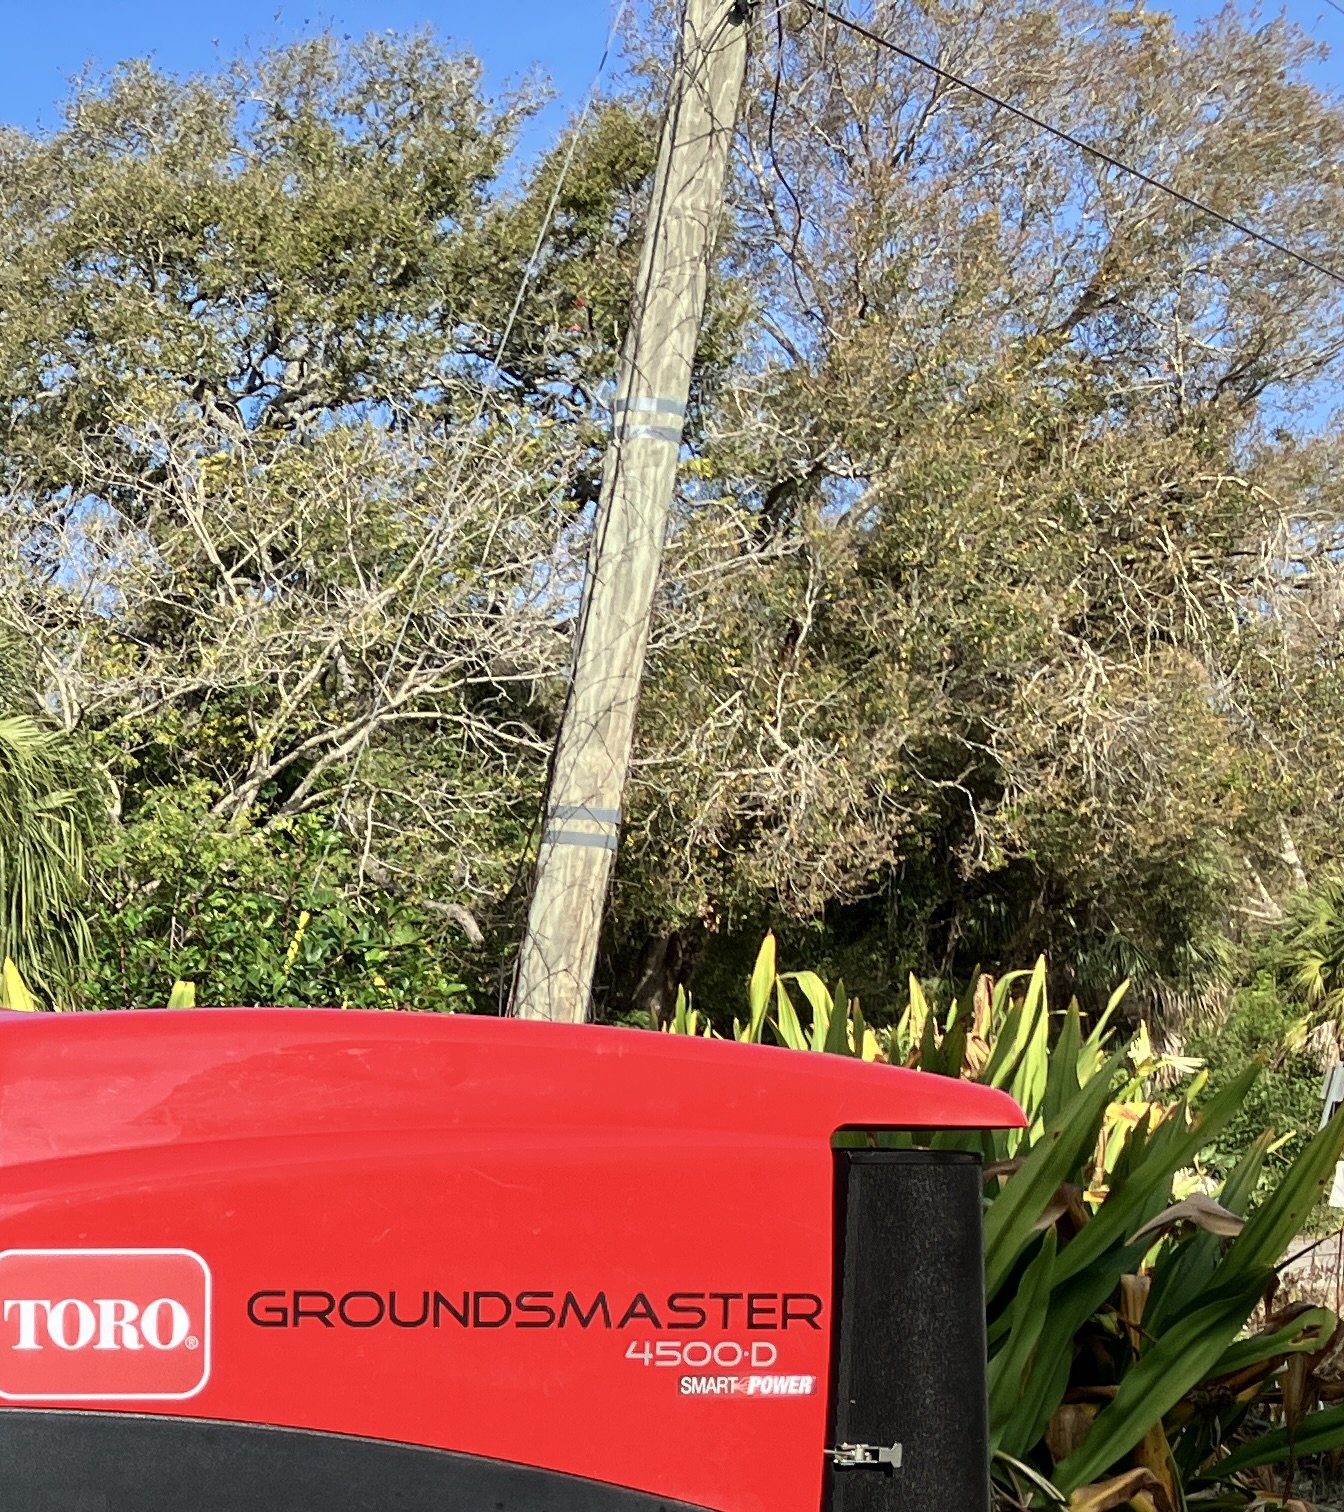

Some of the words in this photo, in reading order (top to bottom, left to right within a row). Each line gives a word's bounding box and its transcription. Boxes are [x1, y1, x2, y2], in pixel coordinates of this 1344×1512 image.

[3, 1297, 191, 1351] TORO
[247, 1290, 823, 1331] GROUNDSMASTER
[680, 1375, 738, 1395] SMART
[747, 1375, 813, 1395] POWER
